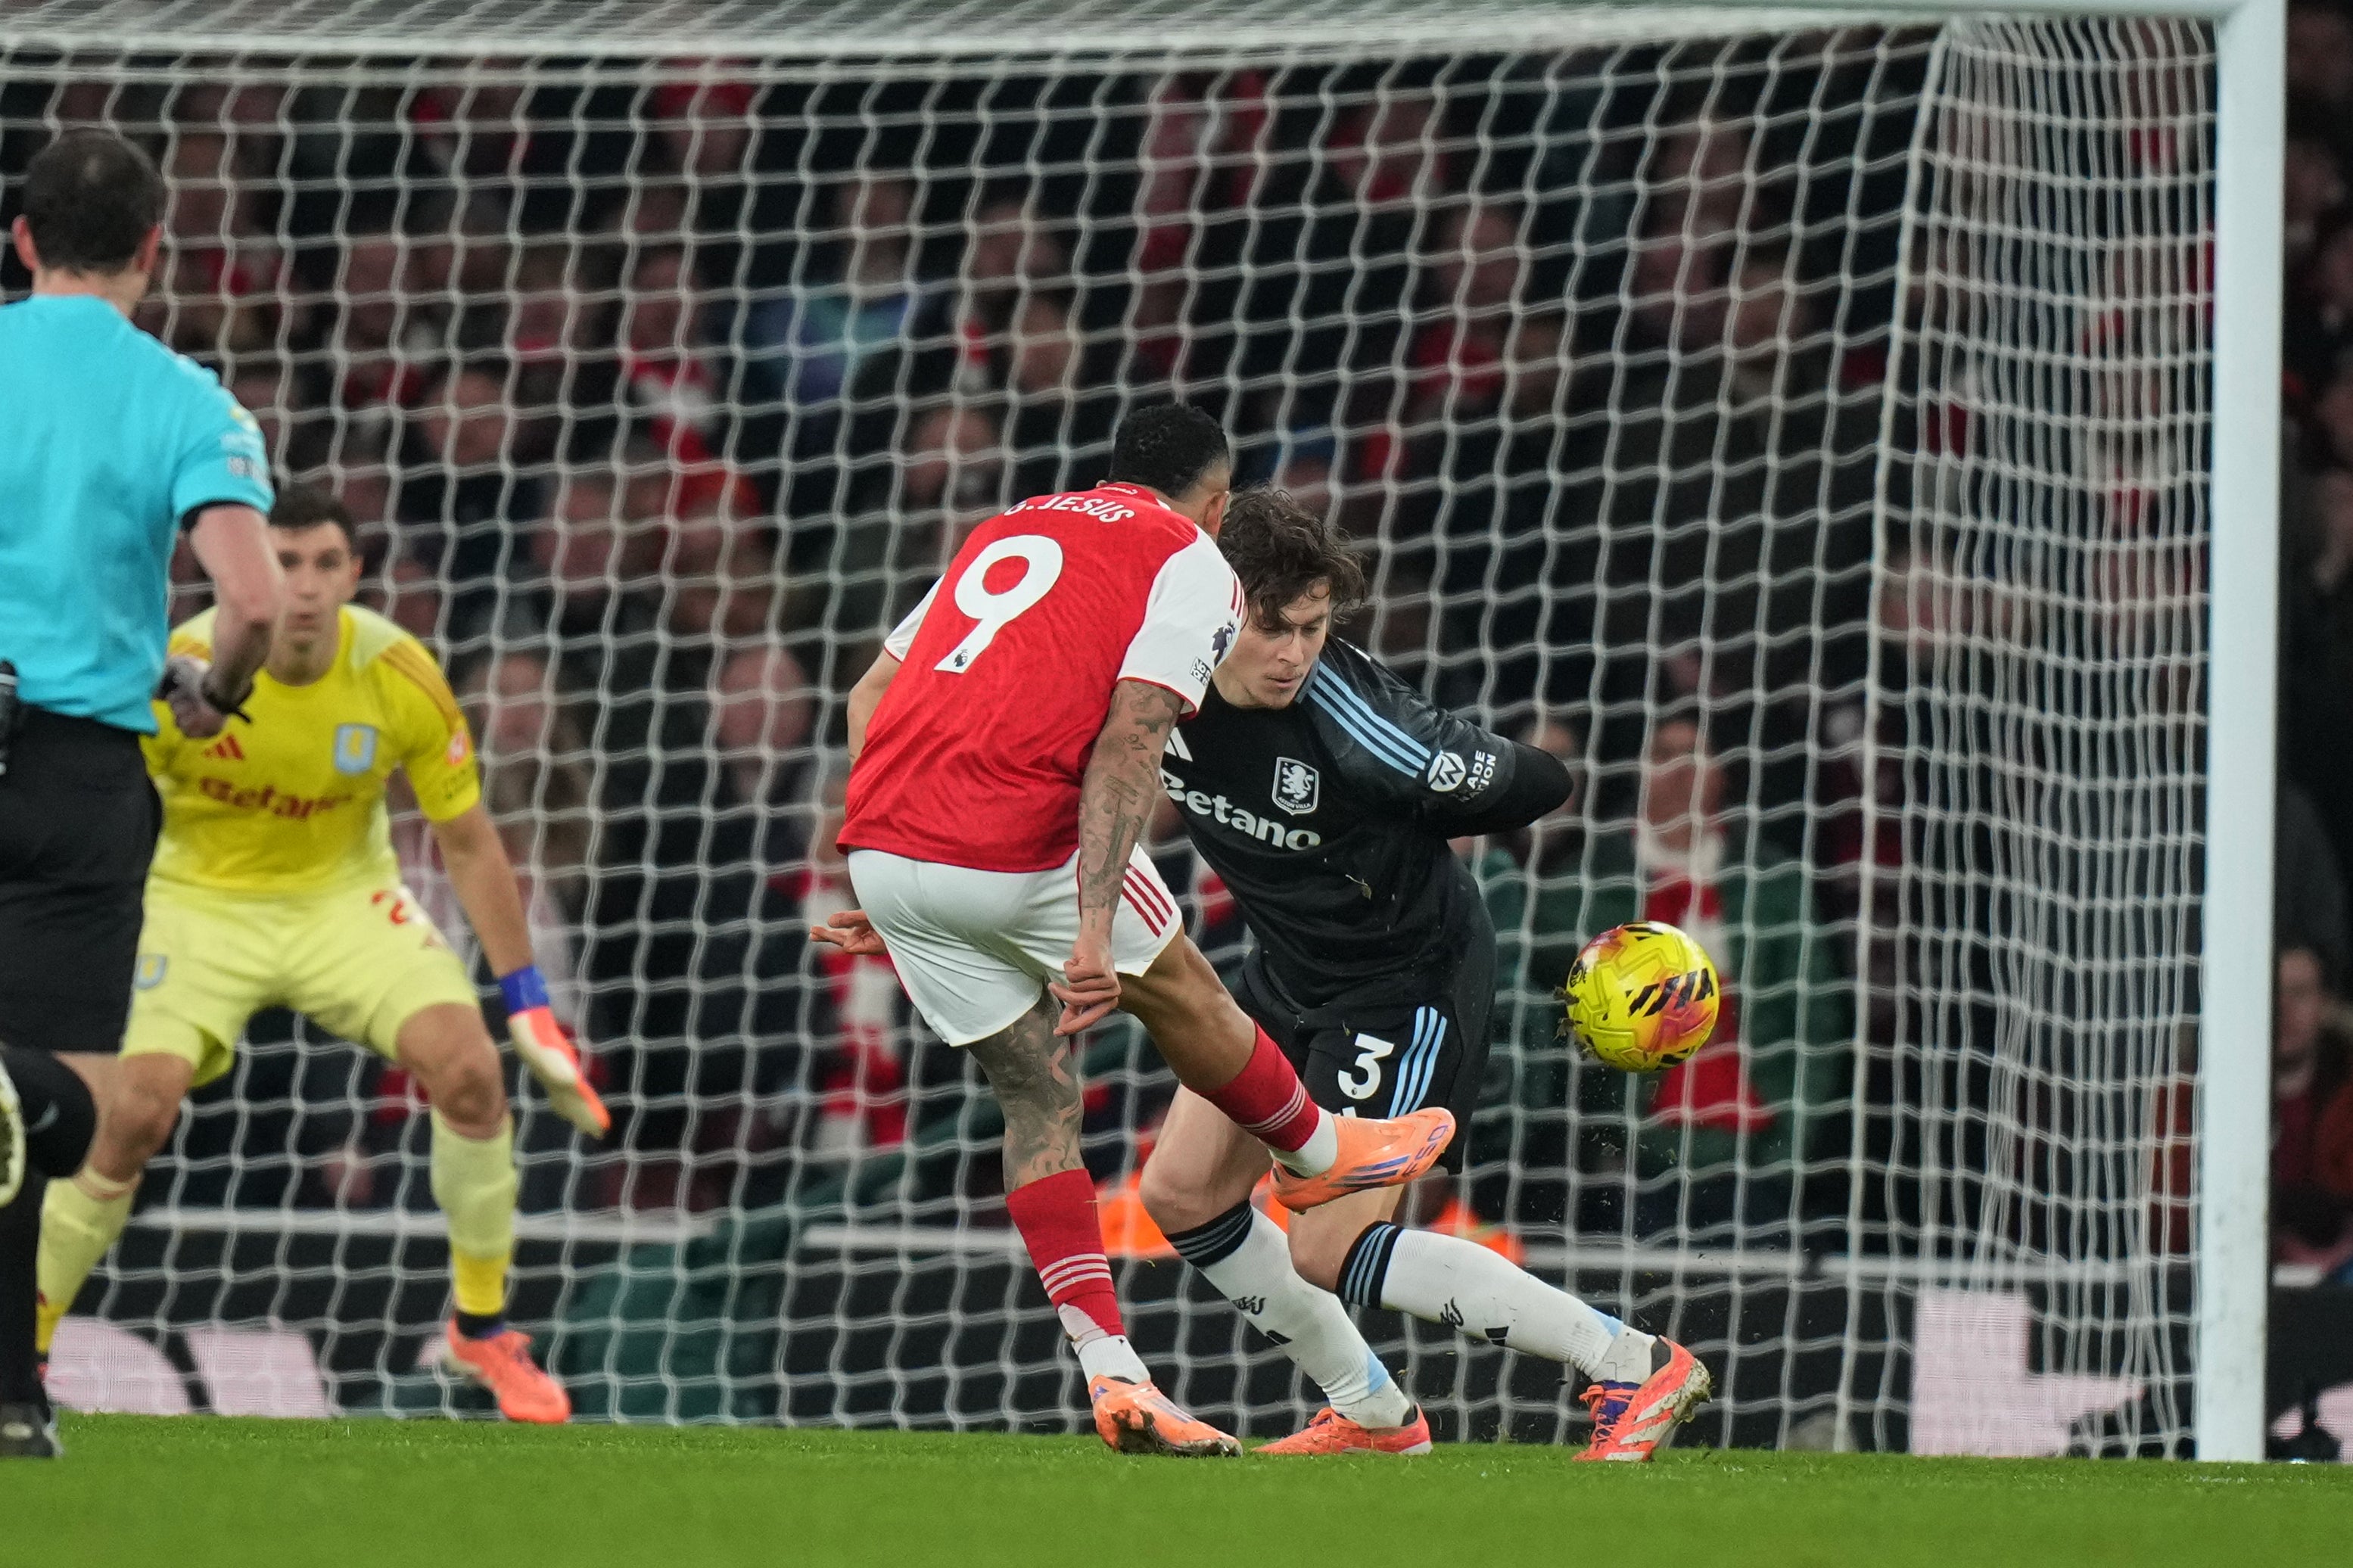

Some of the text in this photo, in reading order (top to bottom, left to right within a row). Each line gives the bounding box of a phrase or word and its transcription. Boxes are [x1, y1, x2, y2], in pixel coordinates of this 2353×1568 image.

[1037, 496, 1135, 523] JESUS
[934, 534, 1063, 674] 9
[1337, 1032, 1395, 1100] 3
